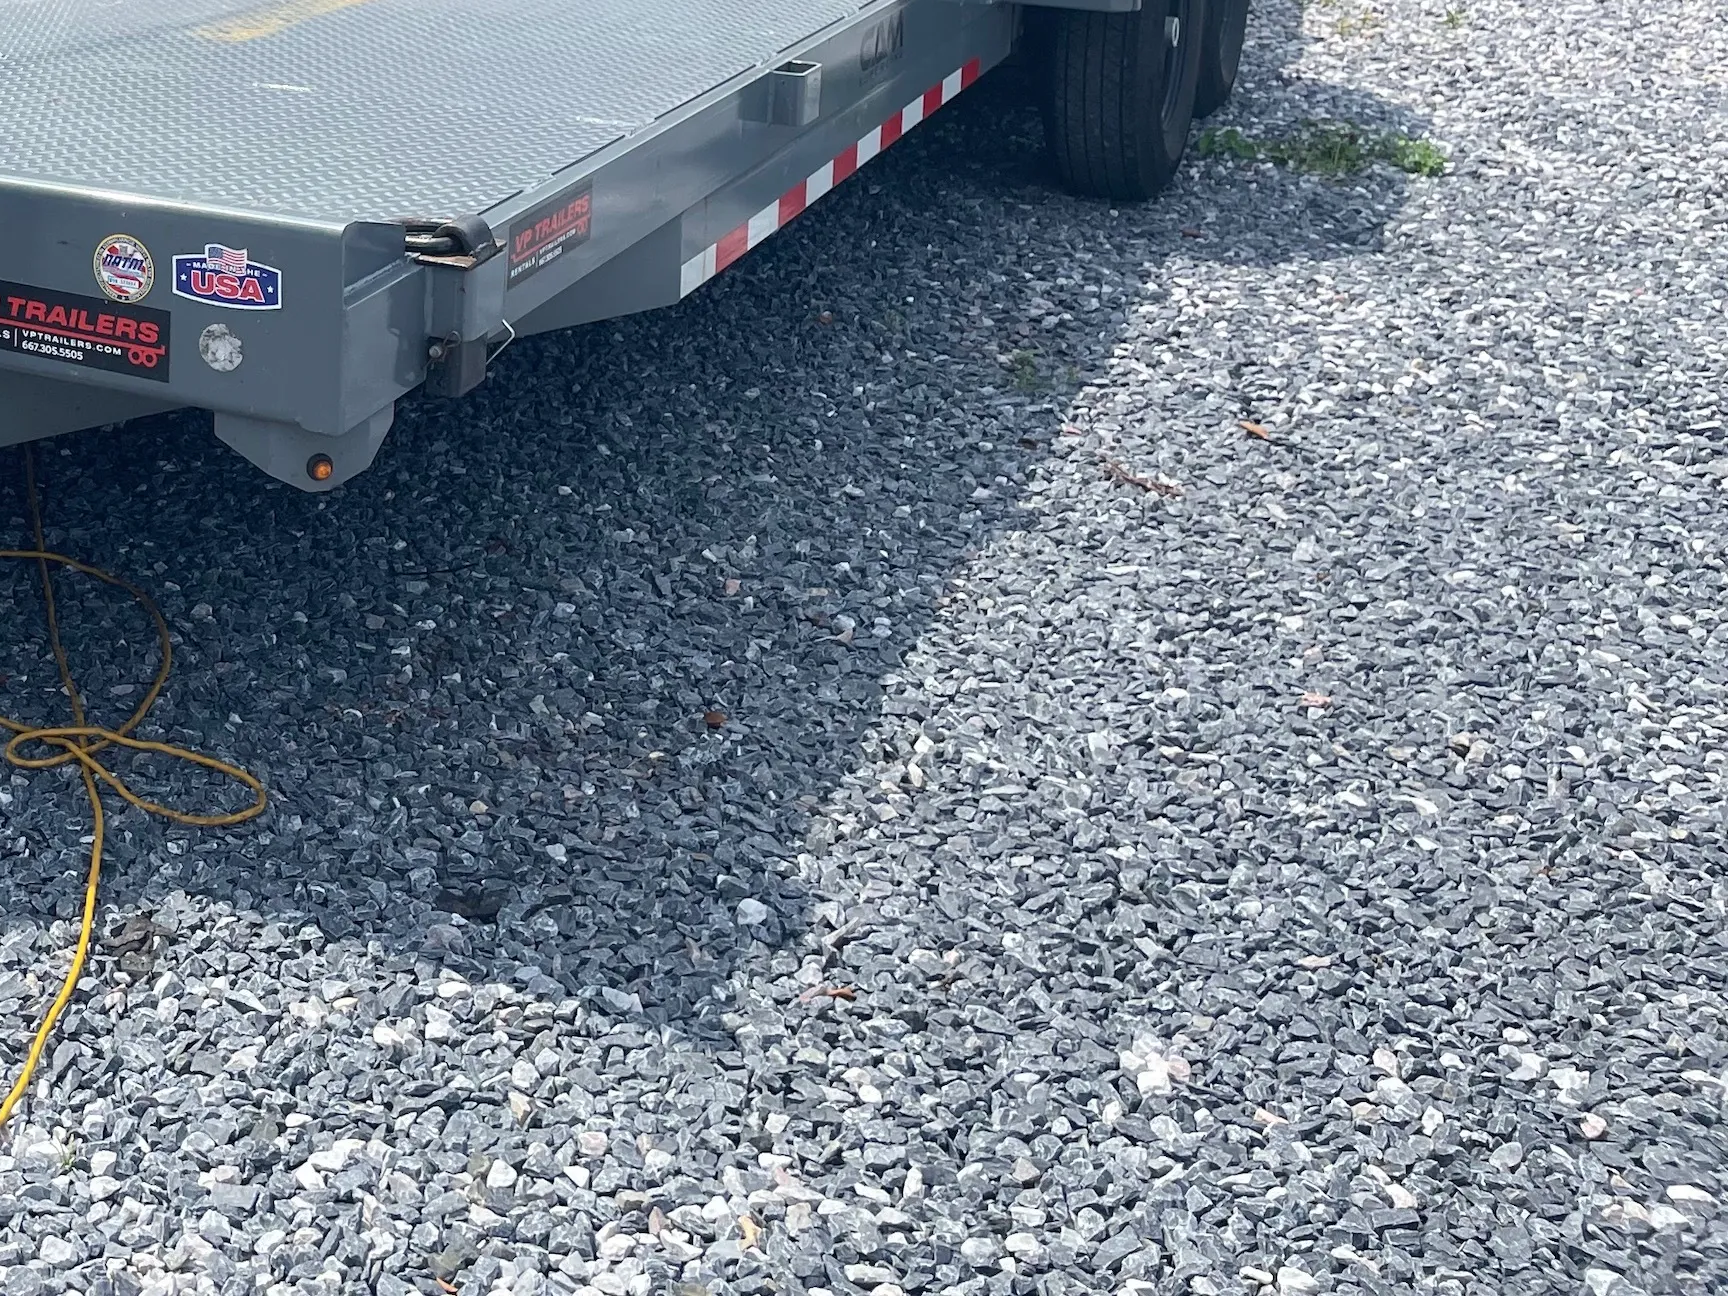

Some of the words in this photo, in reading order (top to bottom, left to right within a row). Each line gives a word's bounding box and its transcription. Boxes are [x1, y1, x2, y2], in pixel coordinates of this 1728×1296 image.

[515, 228, 533, 253] VP
[535, 194, 590, 242] TRAILERS
[193, 262, 221, 271] MADE
[190, 270, 266, 303] USA
[7, 296, 160, 344] TRAILERS
[21, 329, 122, 356] VPTRAILERS.COM
[21, 340, 84, 361] 667.305.5505
